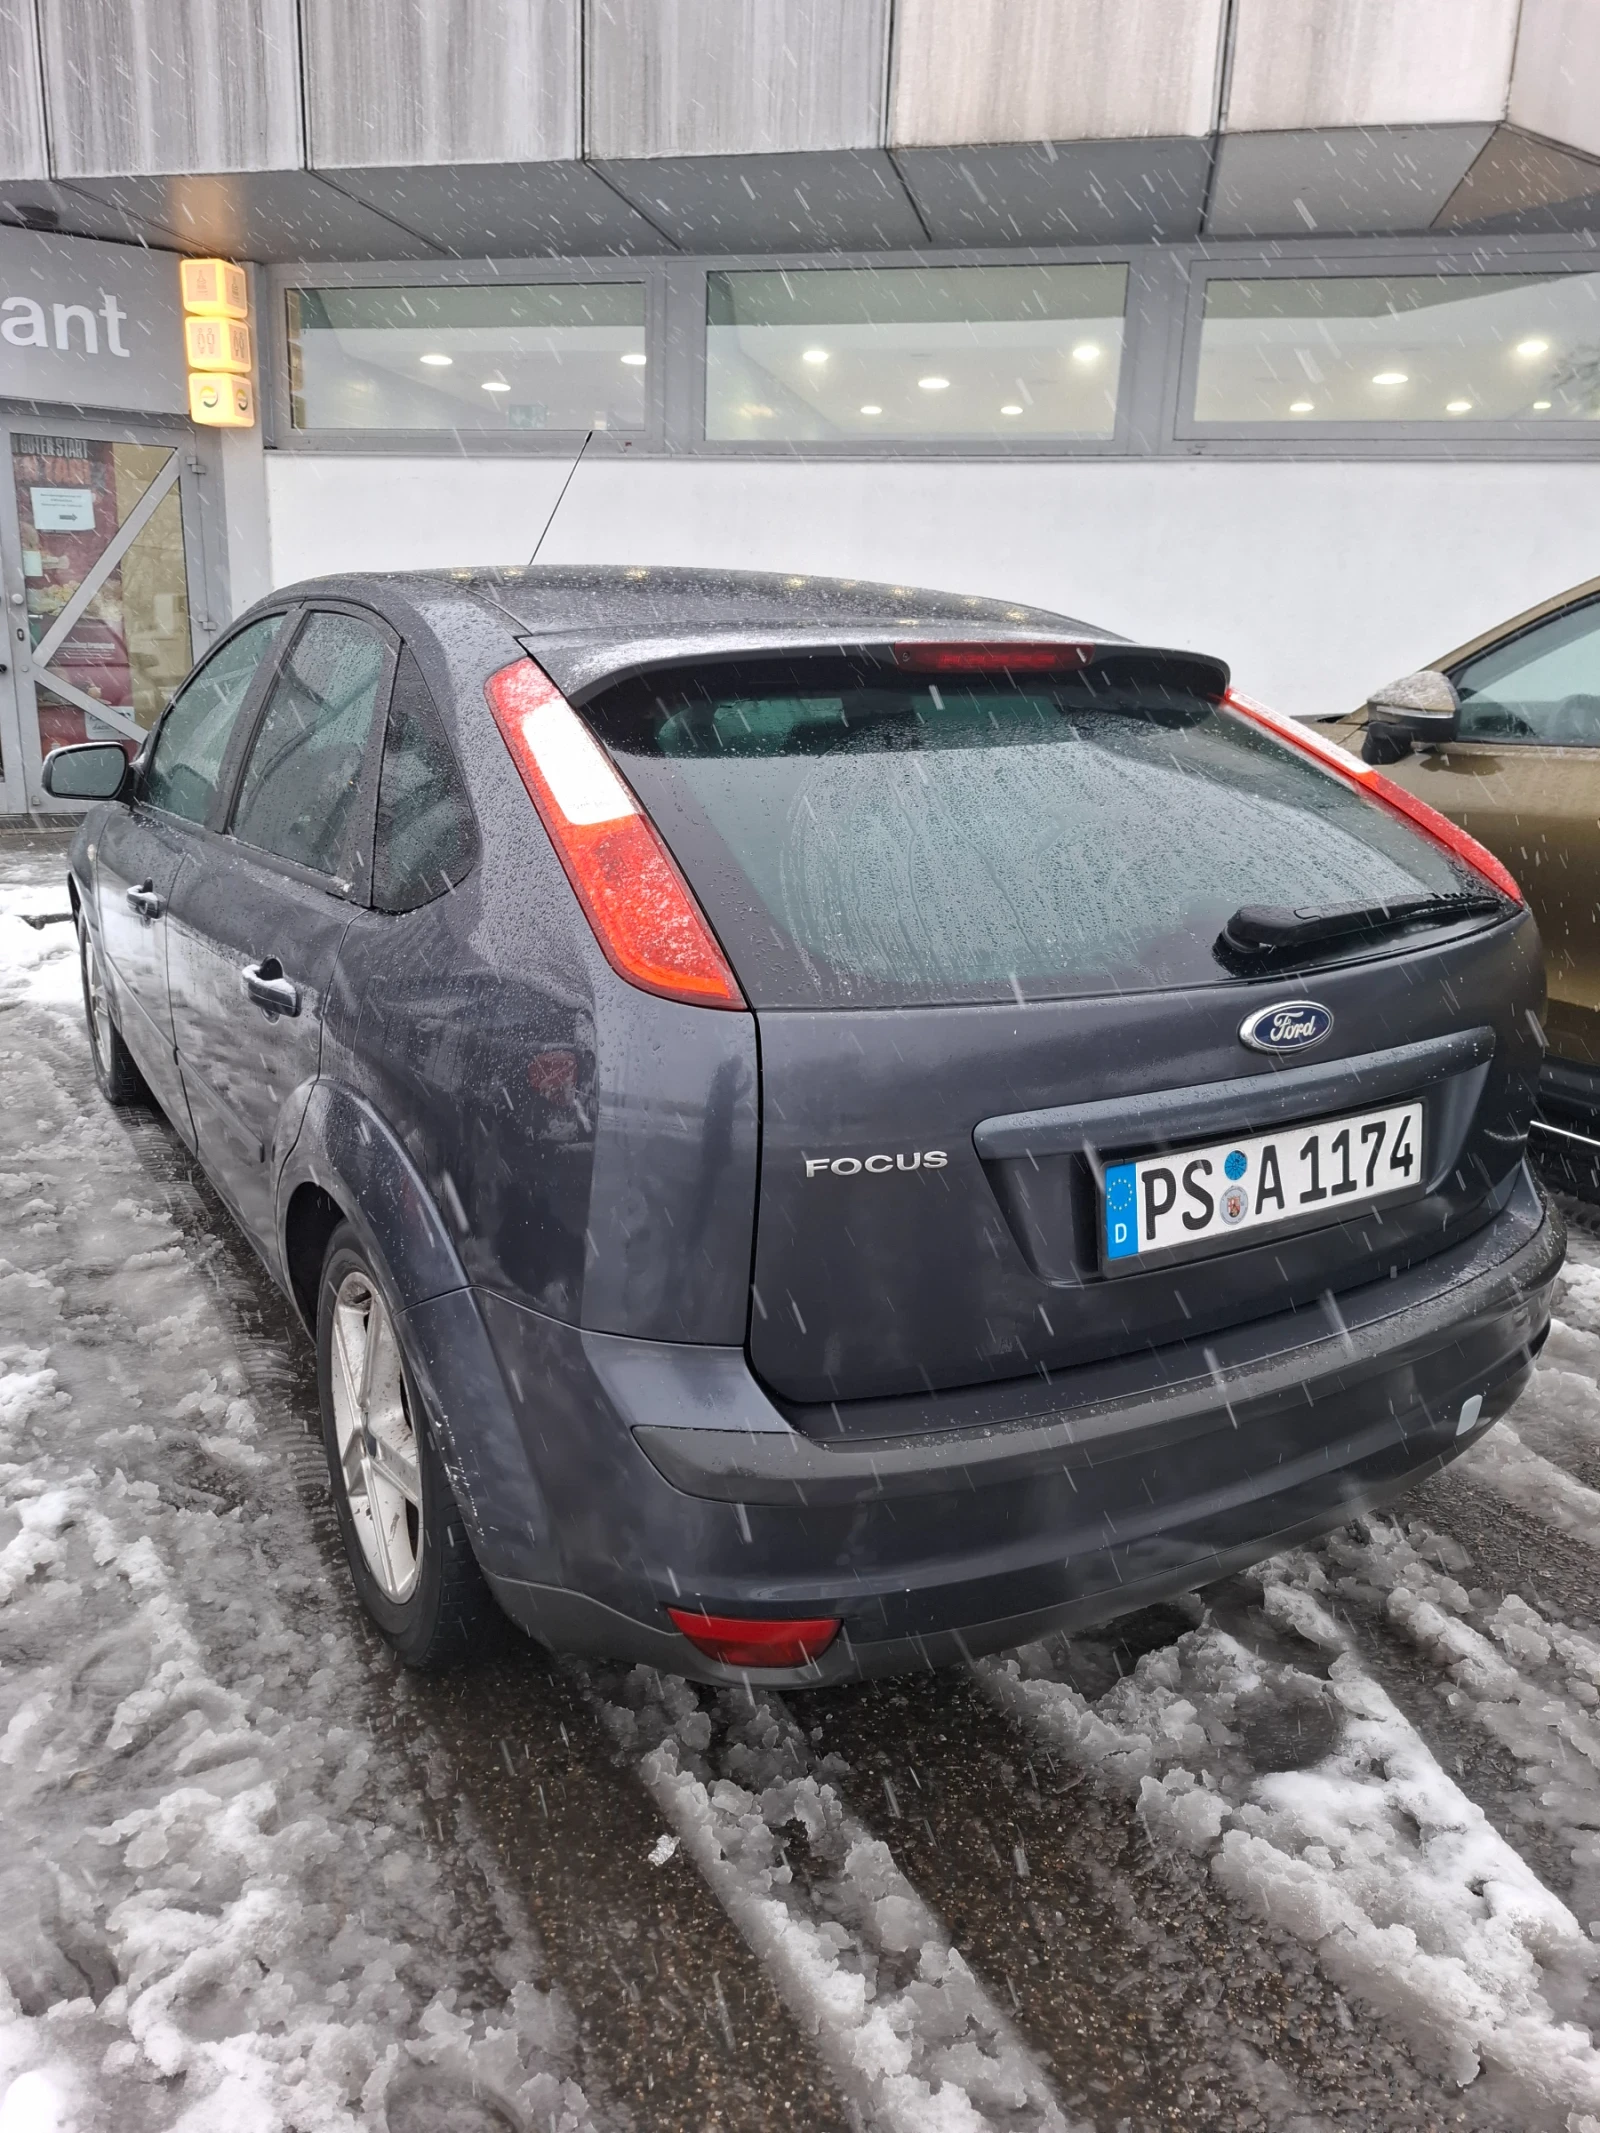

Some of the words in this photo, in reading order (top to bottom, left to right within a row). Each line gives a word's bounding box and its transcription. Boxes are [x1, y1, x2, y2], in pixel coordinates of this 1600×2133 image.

[55, 437, 88, 459] START
[1270, 1011, 1316, 1042] Ford
[806, 1150, 948, 1178] FOCUS
[1141, 1159, 1215, 1241] PS
[1255, 1145, 1285, 1215] A
[1299, 1115, 1414, 1204] 1174
[1115, 1223, 1127, 1244] D
